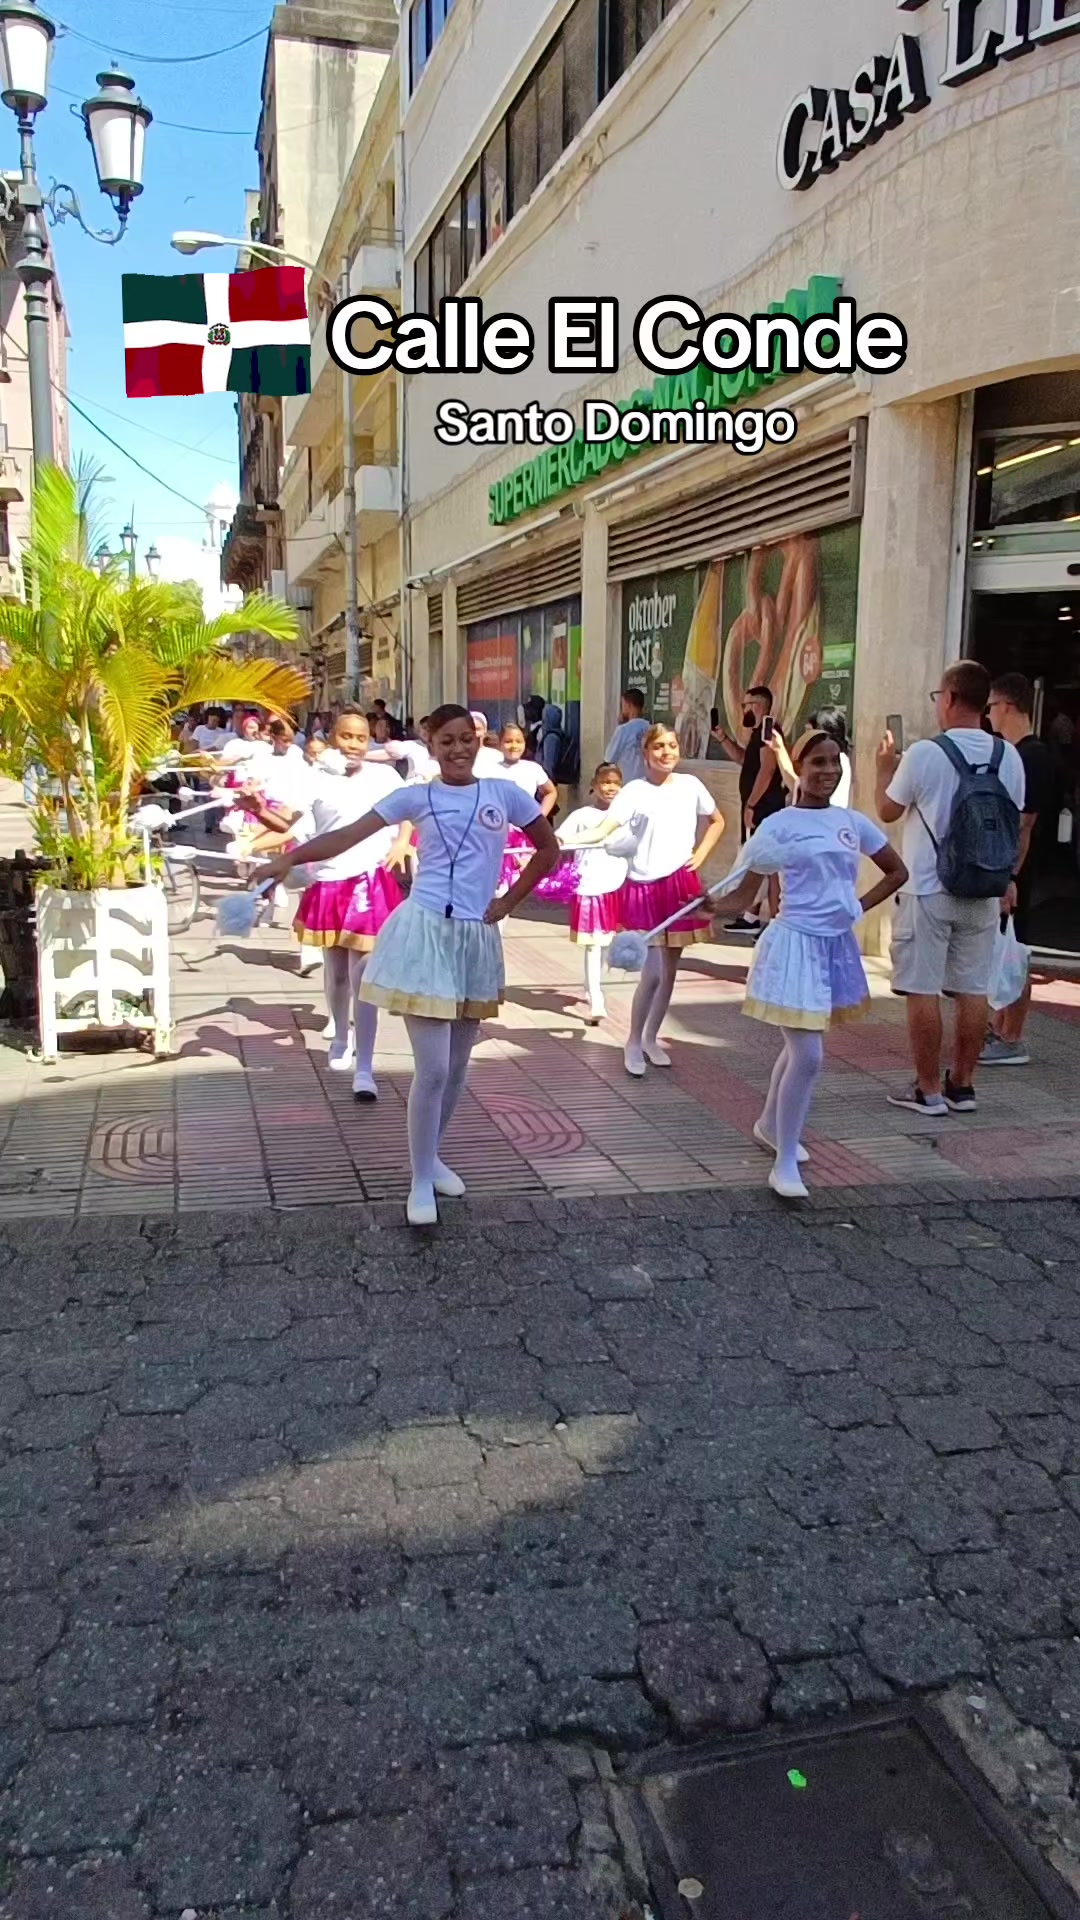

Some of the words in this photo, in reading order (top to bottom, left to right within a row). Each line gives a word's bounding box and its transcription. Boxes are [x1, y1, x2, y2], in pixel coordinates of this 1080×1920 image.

[776, 33, 930, 191] CASA
[628, 592, 677, 633] oktober
[628, 633, 652, 672] fest
